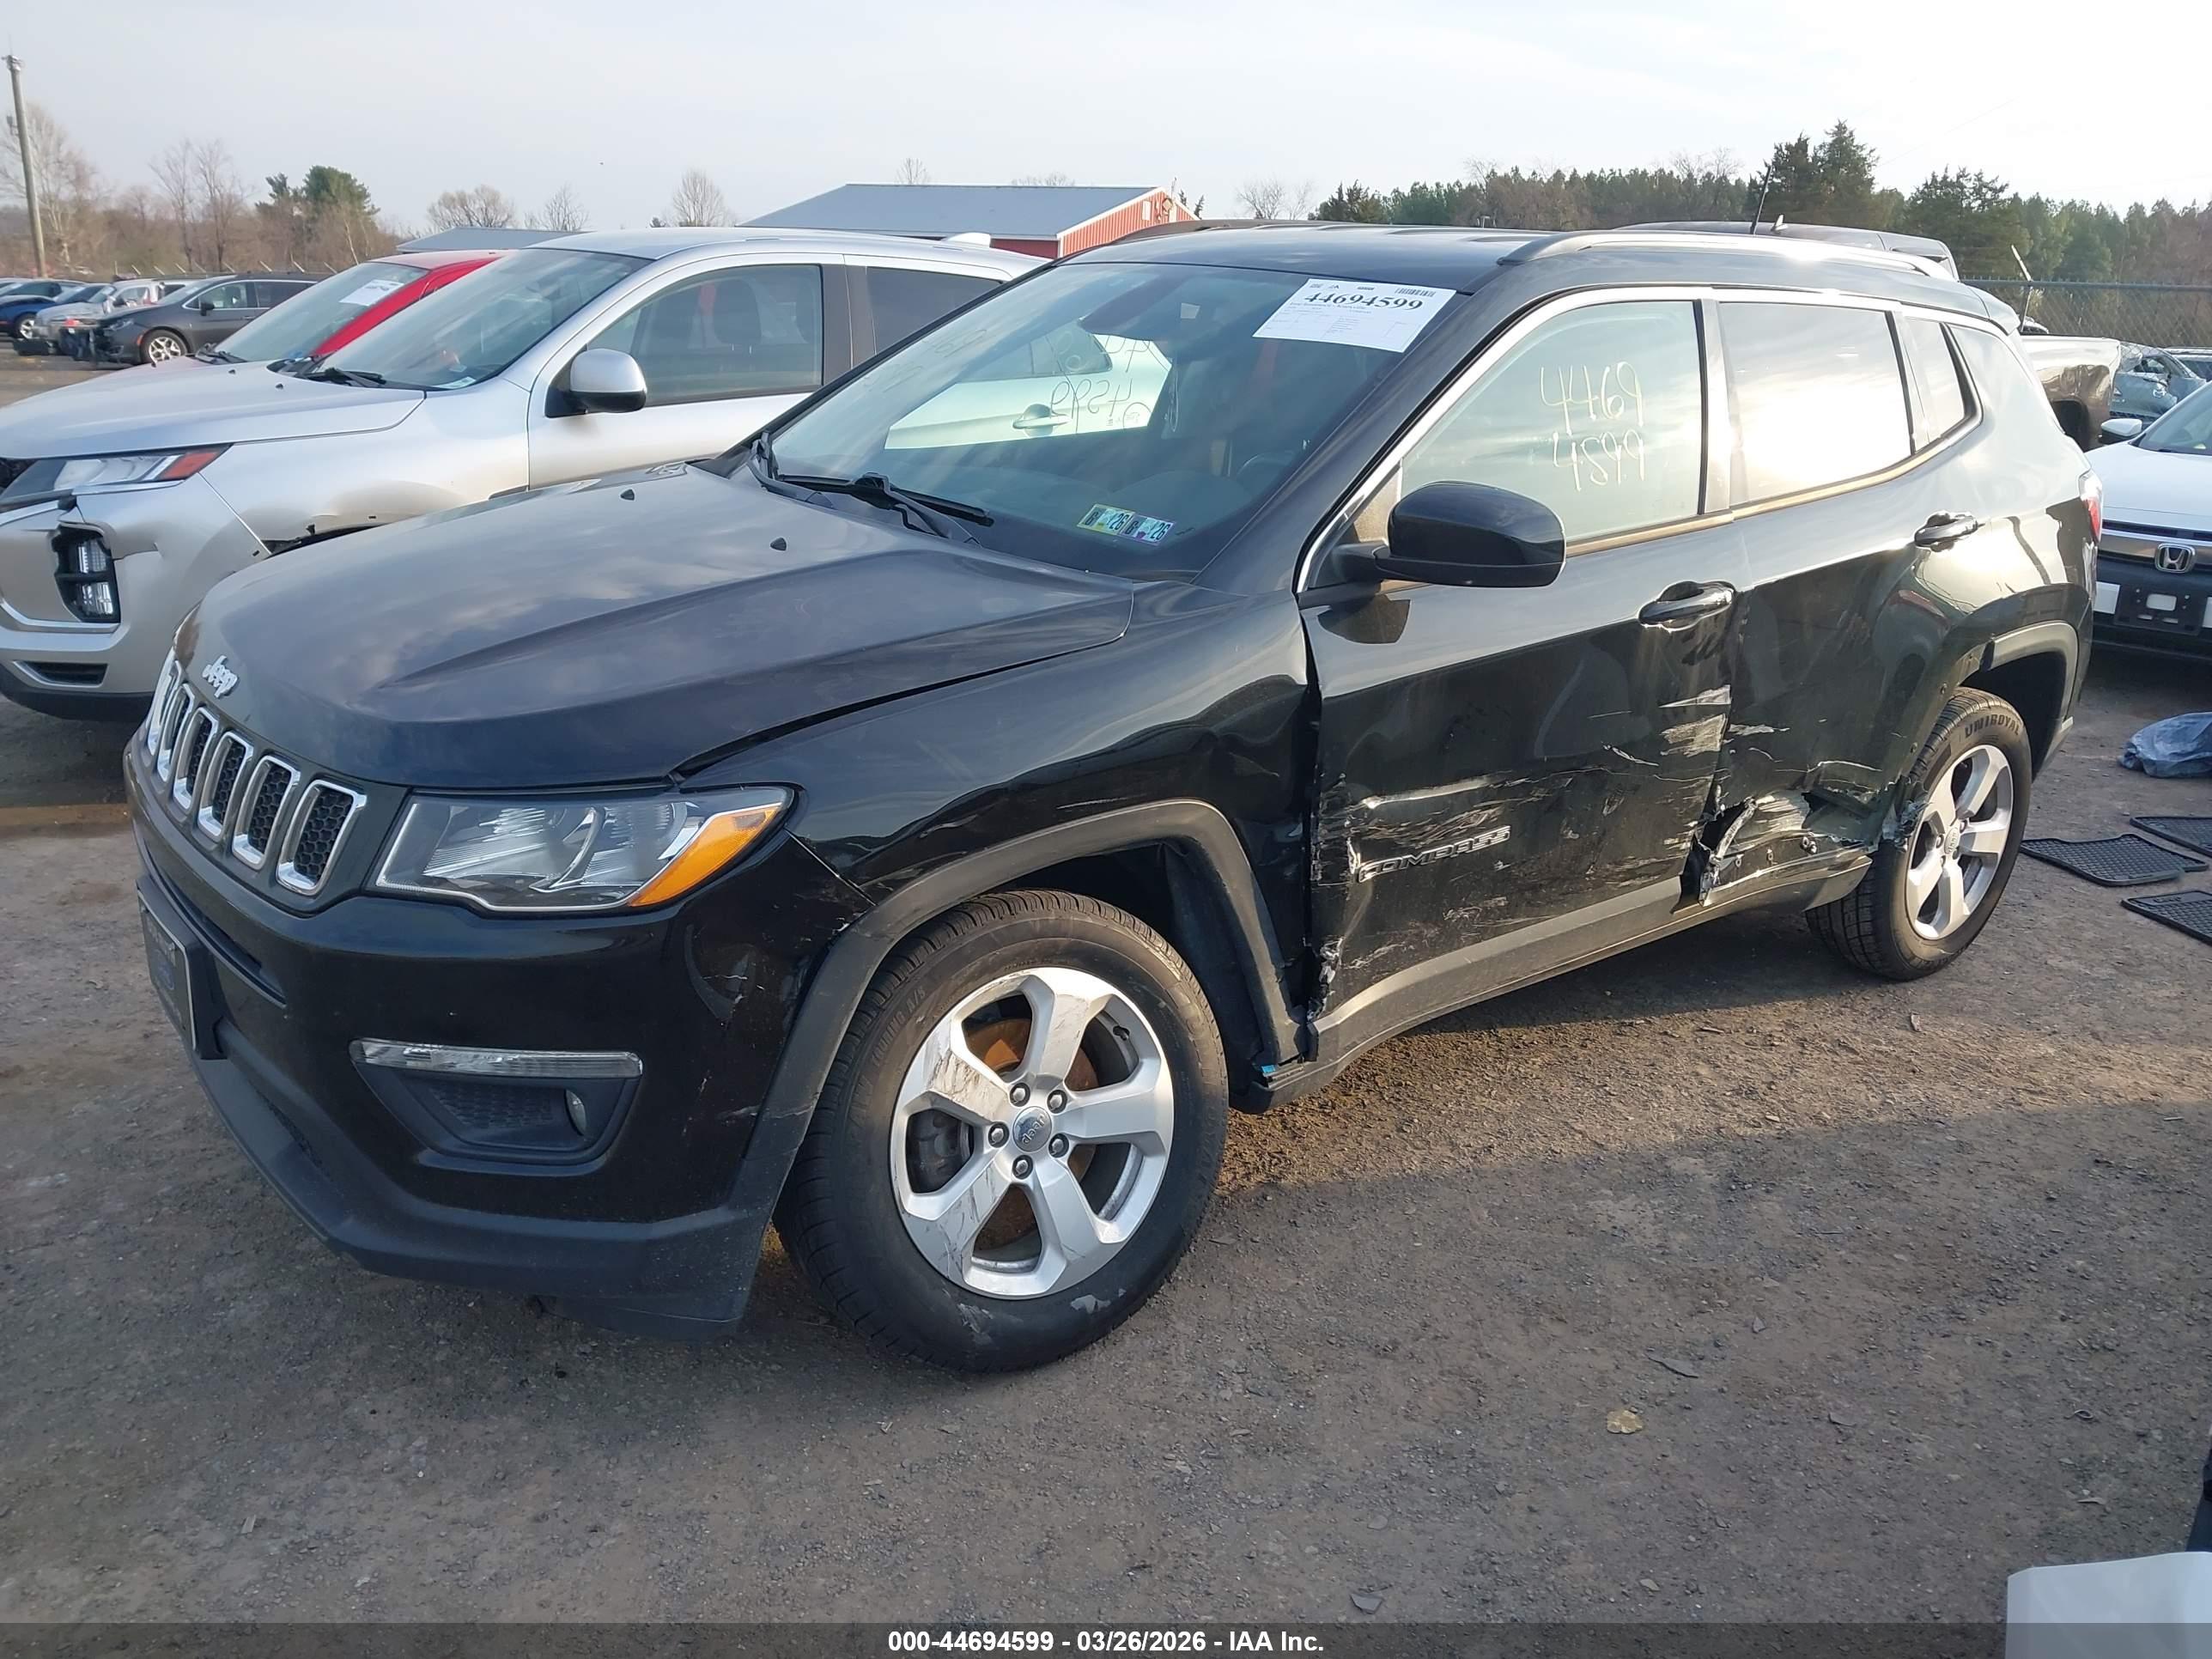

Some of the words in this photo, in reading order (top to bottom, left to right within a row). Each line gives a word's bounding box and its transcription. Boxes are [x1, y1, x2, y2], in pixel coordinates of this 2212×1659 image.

[1304, 292, 1423, 311] 44694599
[1540, 361, 1644, 437] 4469
[1553, 428, 1645, 492] 4599
[202, 655, 238, 698] Jeep
[1964, 714, 2021, 738] UNIROYAL
[1358, 825, 1511, 884] COMPASS
[1023, 1114, 1046, 1145] Jeep
